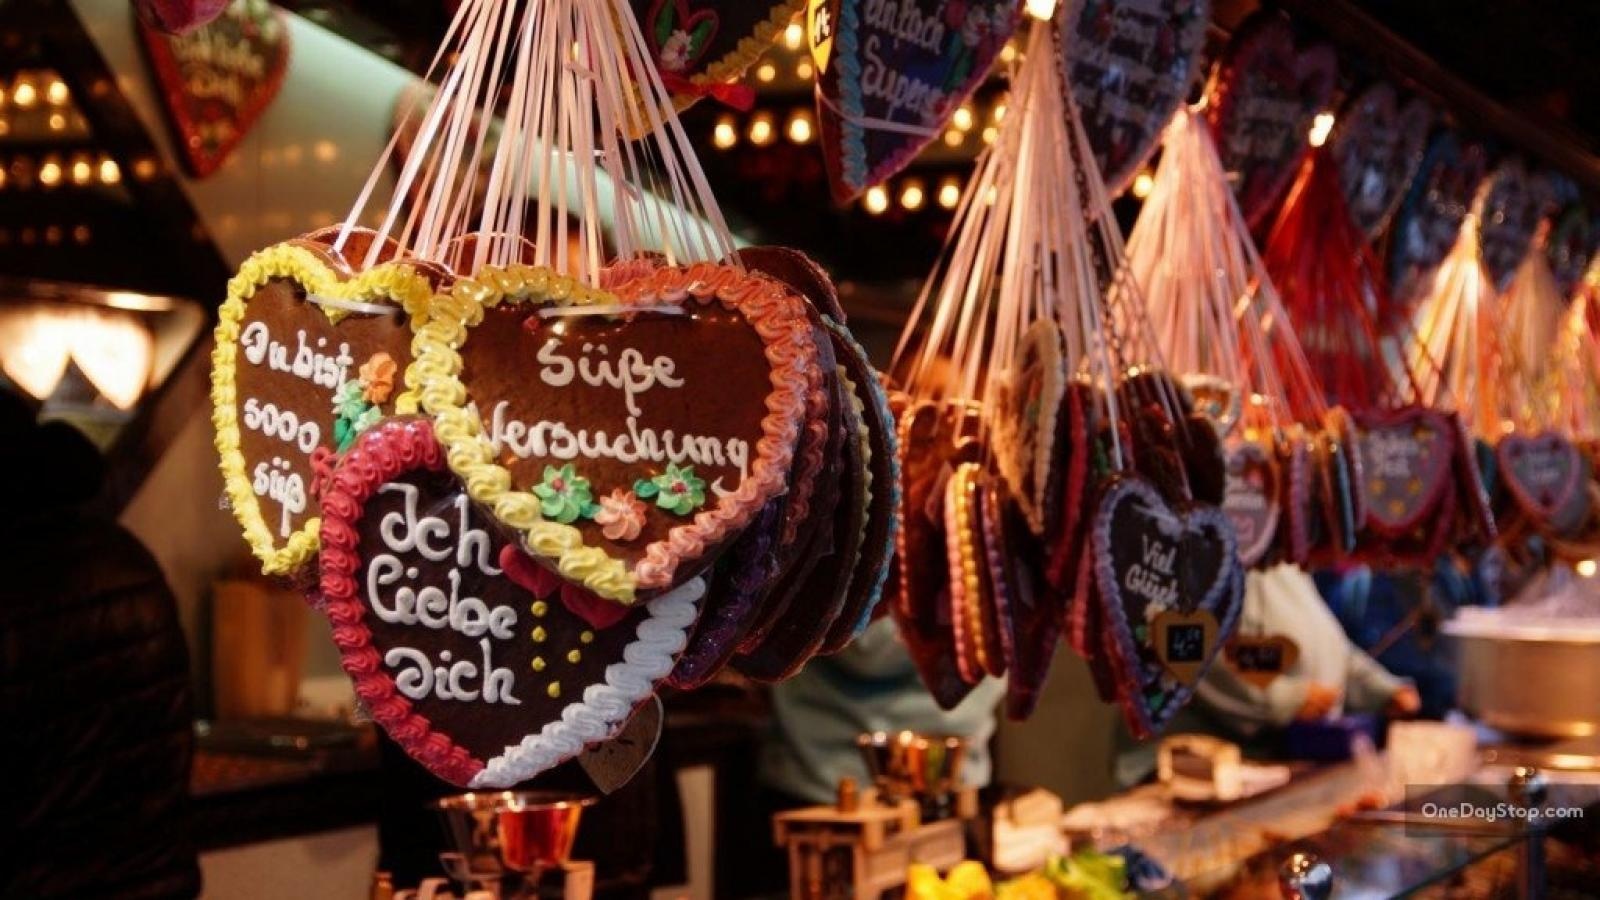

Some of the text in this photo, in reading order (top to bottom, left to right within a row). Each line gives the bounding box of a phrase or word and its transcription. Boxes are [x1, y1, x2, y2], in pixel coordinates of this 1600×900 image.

[536, 339, 685, 417] Süße
[244, 398, 320, 453] sooo
[466, 400, 749, 497] Versuchung
